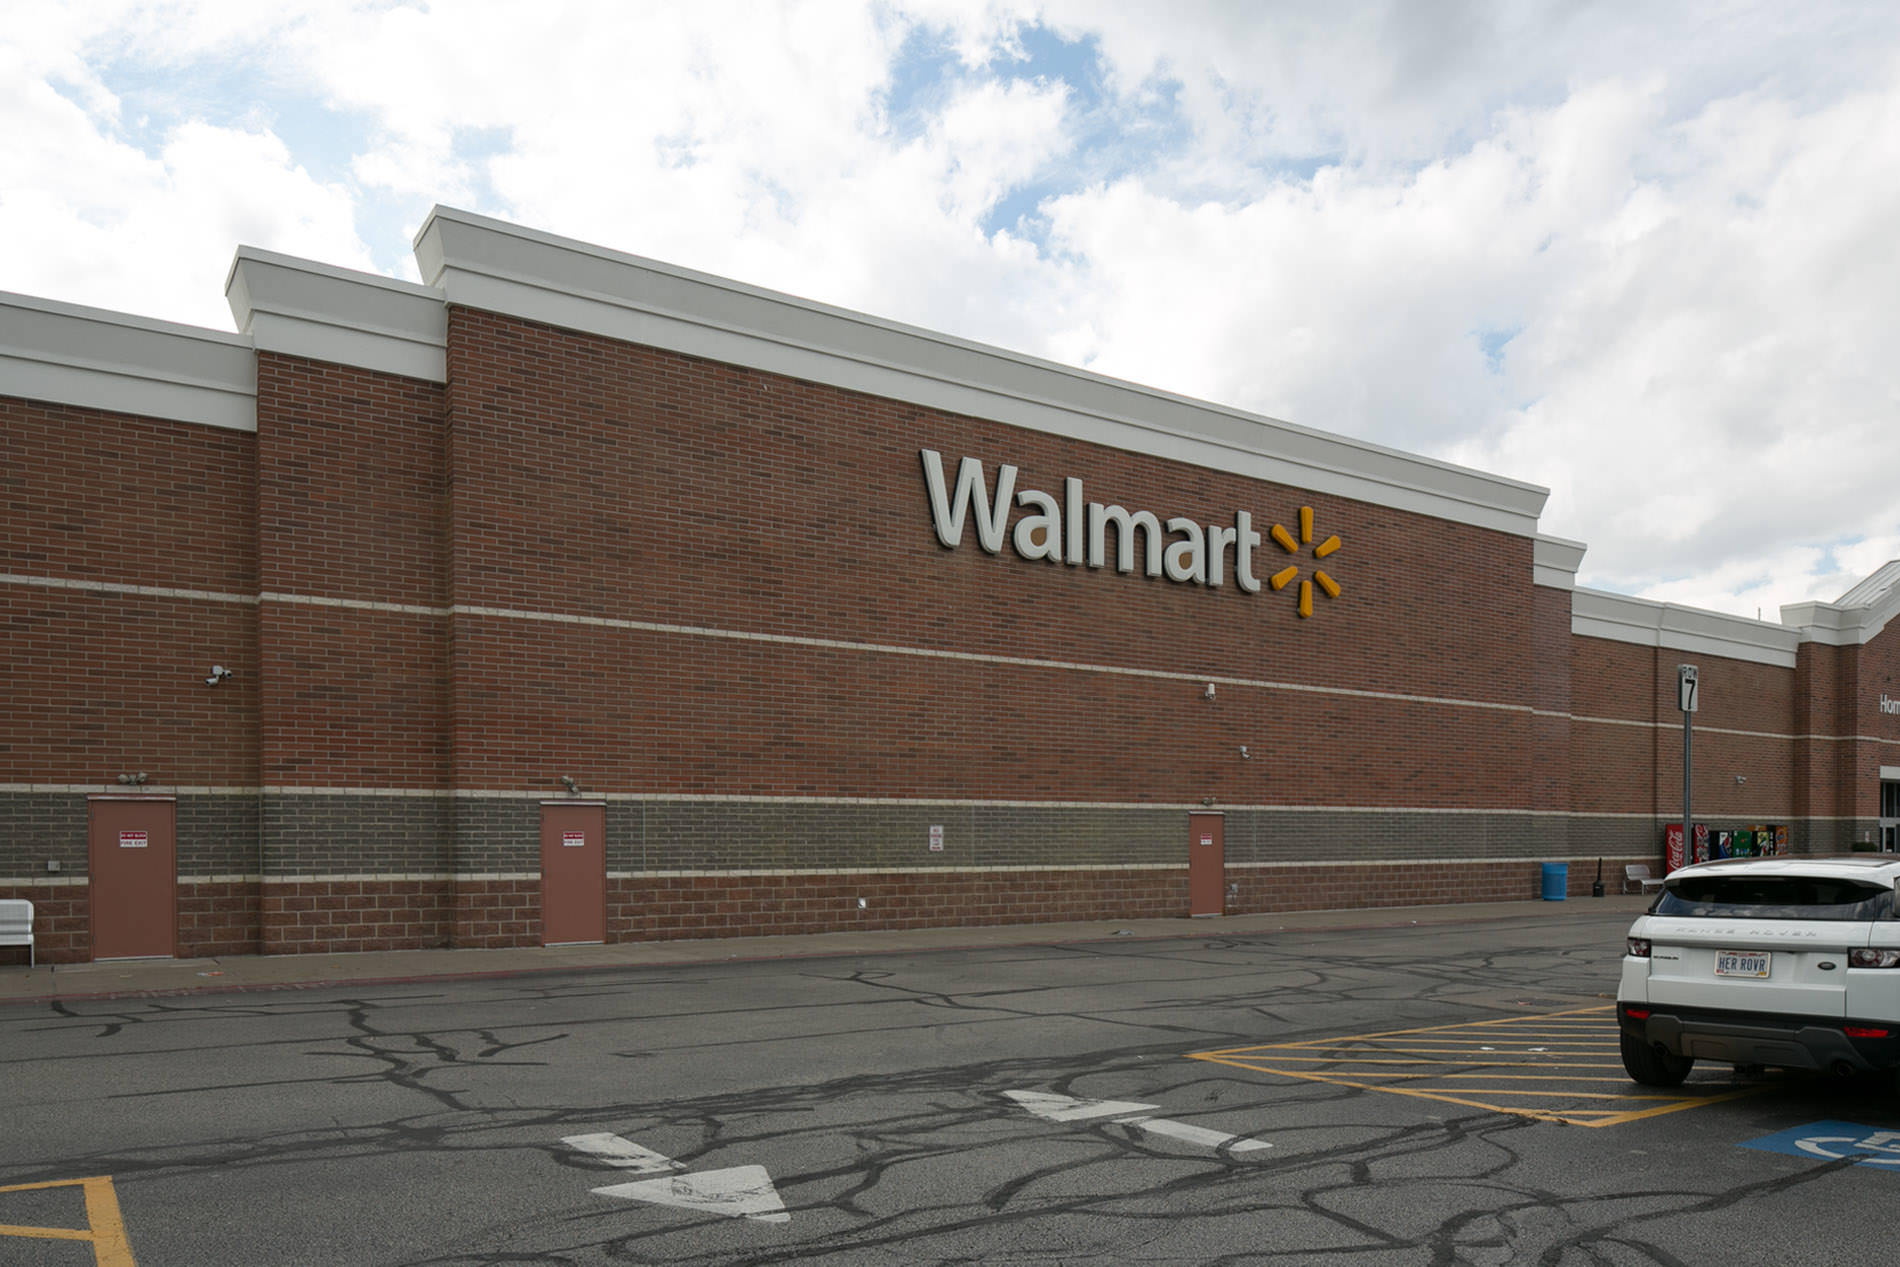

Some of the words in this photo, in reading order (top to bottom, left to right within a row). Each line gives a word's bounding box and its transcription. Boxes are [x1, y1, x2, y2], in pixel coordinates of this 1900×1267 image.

[920, 448, 1261, 593] Walmart
[1684, 679, 1696, 710] 7
[1718, 956, 1737, 970] HER
[1740, 958, 1766, 972] ROVR
